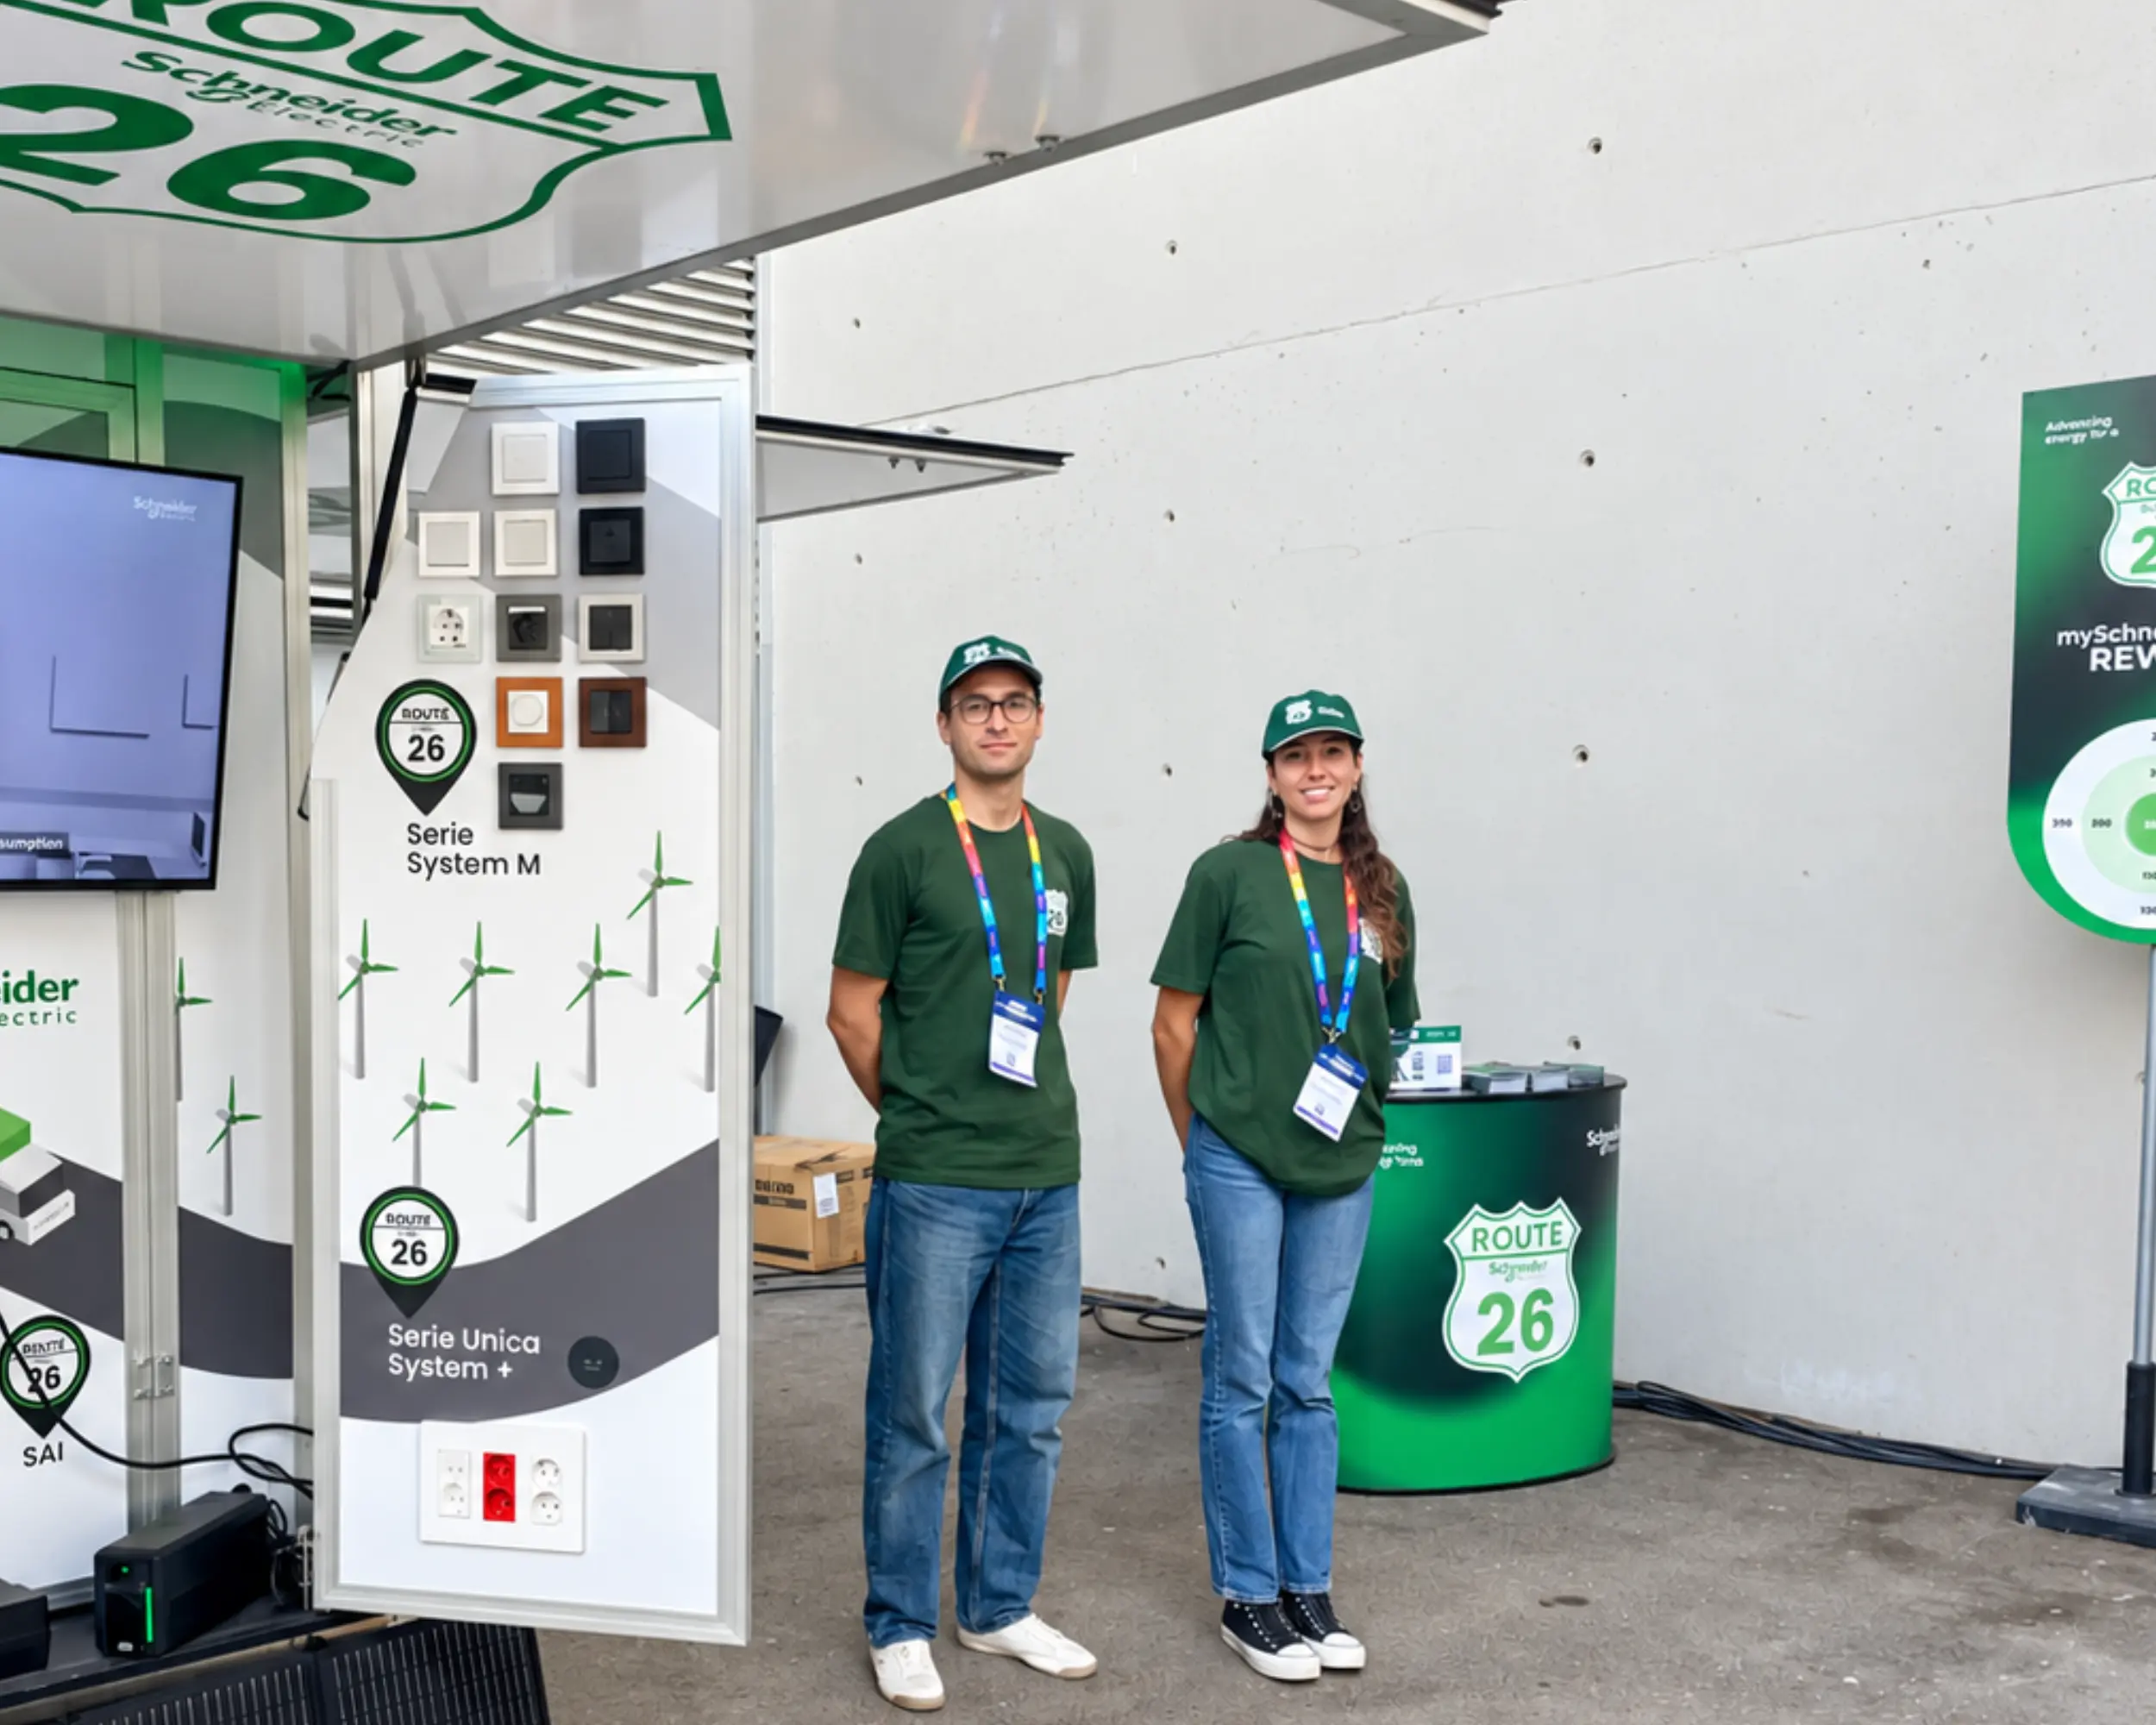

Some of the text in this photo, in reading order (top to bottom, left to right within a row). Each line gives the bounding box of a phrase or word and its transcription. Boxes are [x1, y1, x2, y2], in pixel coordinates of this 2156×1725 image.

[121, 50, 458, 137] Schneider
[0, 83, 417, 220] 26
[2130, 525, 2156, 575] 2
[2056, 622, 2156, 649] mySchn
[407, 733, 445, 762] 26
[407, 821, 474, 846] Serie
[407, 850, 541, 882] System M
[2, 969, 79, 1004] ider
[385, 1213, 431, 1226] ROUTE
[1471, 1221, 1563, 1252] ROUTE
[390, 1239, 428, 1266] 26
[1476, 1288, 1554, 1356] 26
[388, 1323, 540, 1354] Serie Unica
[388, 1353, 488, 1382] System
[22, 1441, 64, 1467] SAI
